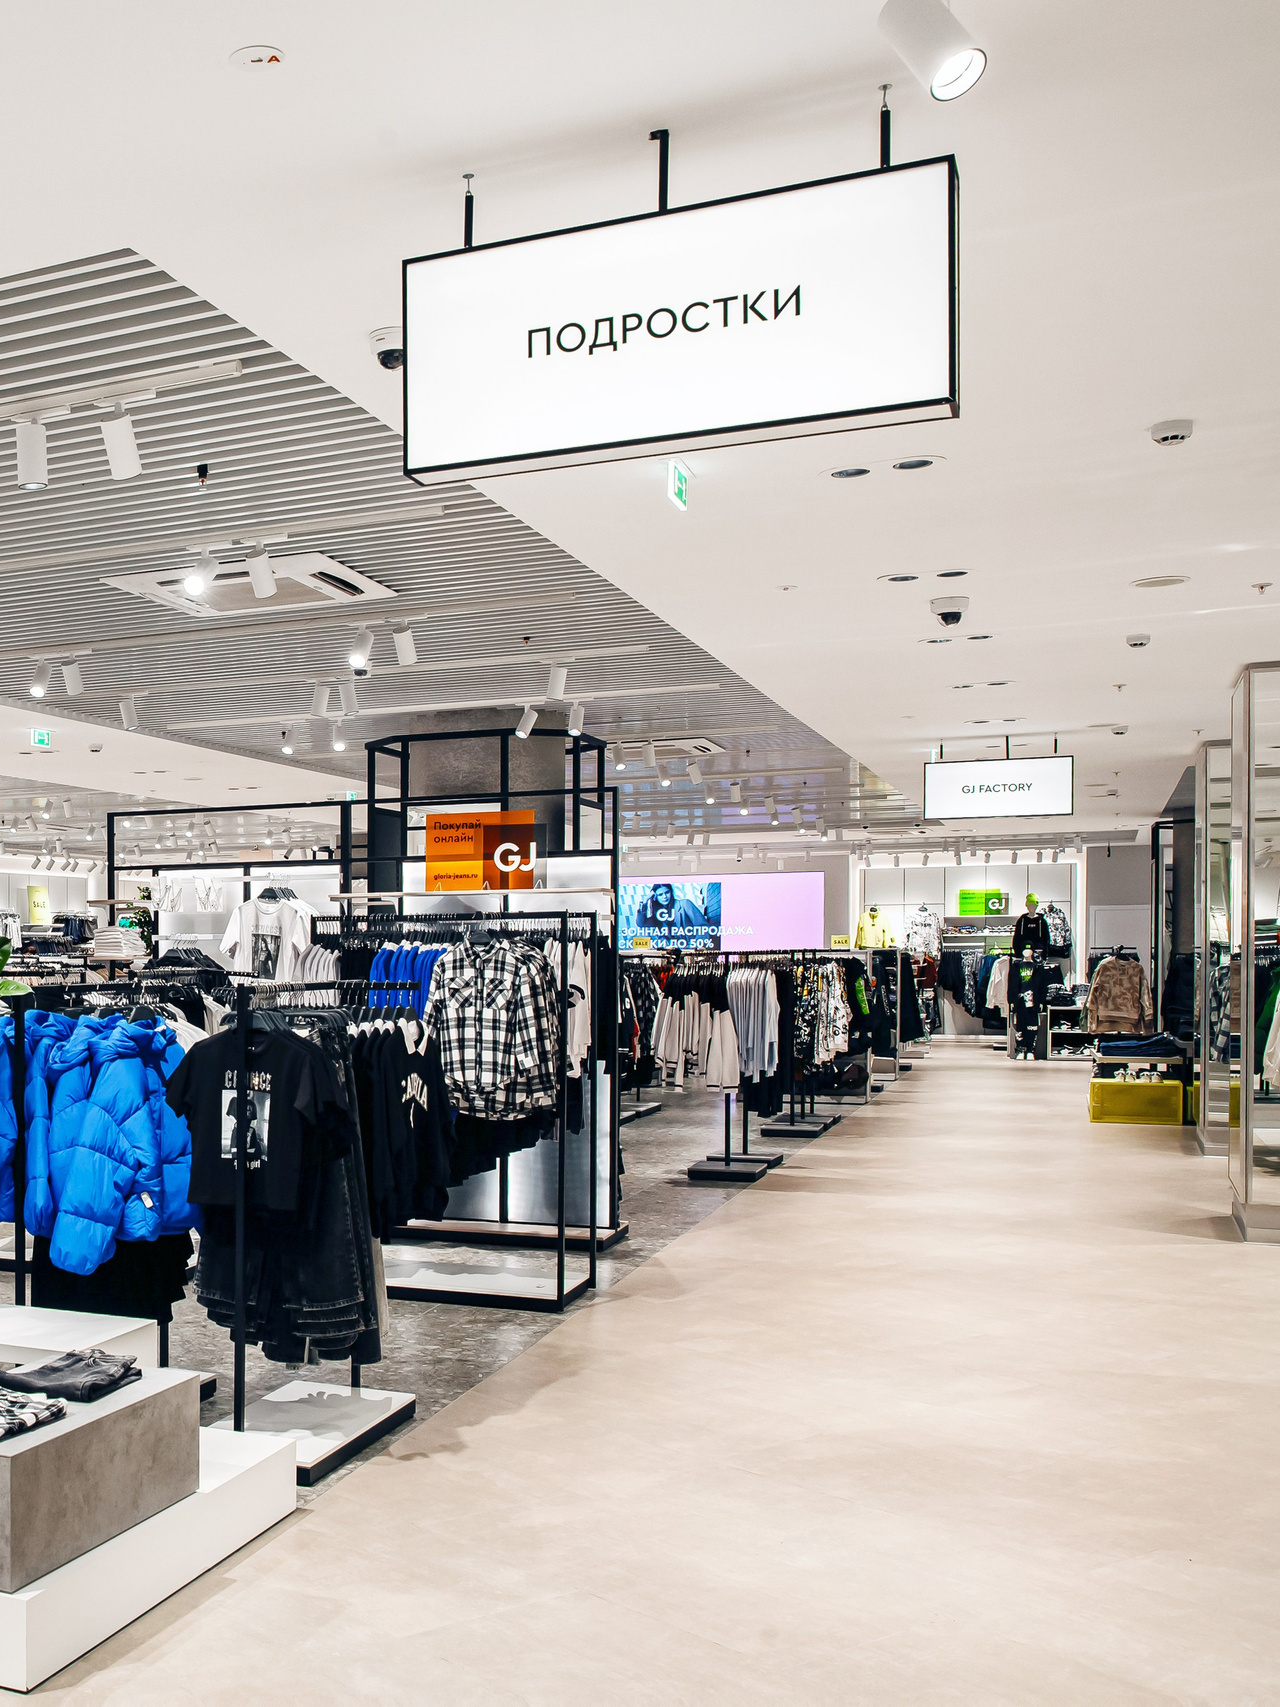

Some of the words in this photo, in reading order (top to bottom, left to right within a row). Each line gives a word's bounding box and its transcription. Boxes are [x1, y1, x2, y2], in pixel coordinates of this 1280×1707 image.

[528, 284, 801, 358] ПОДРОСТКИ
[961, 785, 975, 794] GJ
[979, 782, 1033, 793] FACTORY
[433, 819, 482, 831] Покупай
[433, 832, 474, 843] онлайн
[493, 841, 537, 873] GJ
[433, 872, 479, 880] gloria-jeans.ru
[988, 898, 1006, 910] GJ
[656, 908, 676, 922] GJ
[618, 926, 668, 937] ЗОННАЯ
[671, 925, 754, 937] РАСПРОДАЖА
[618, 940, 666, 949] СККИ
[669, 939, 686, 950] ДО
[689, 938, 715, 949] 50%
